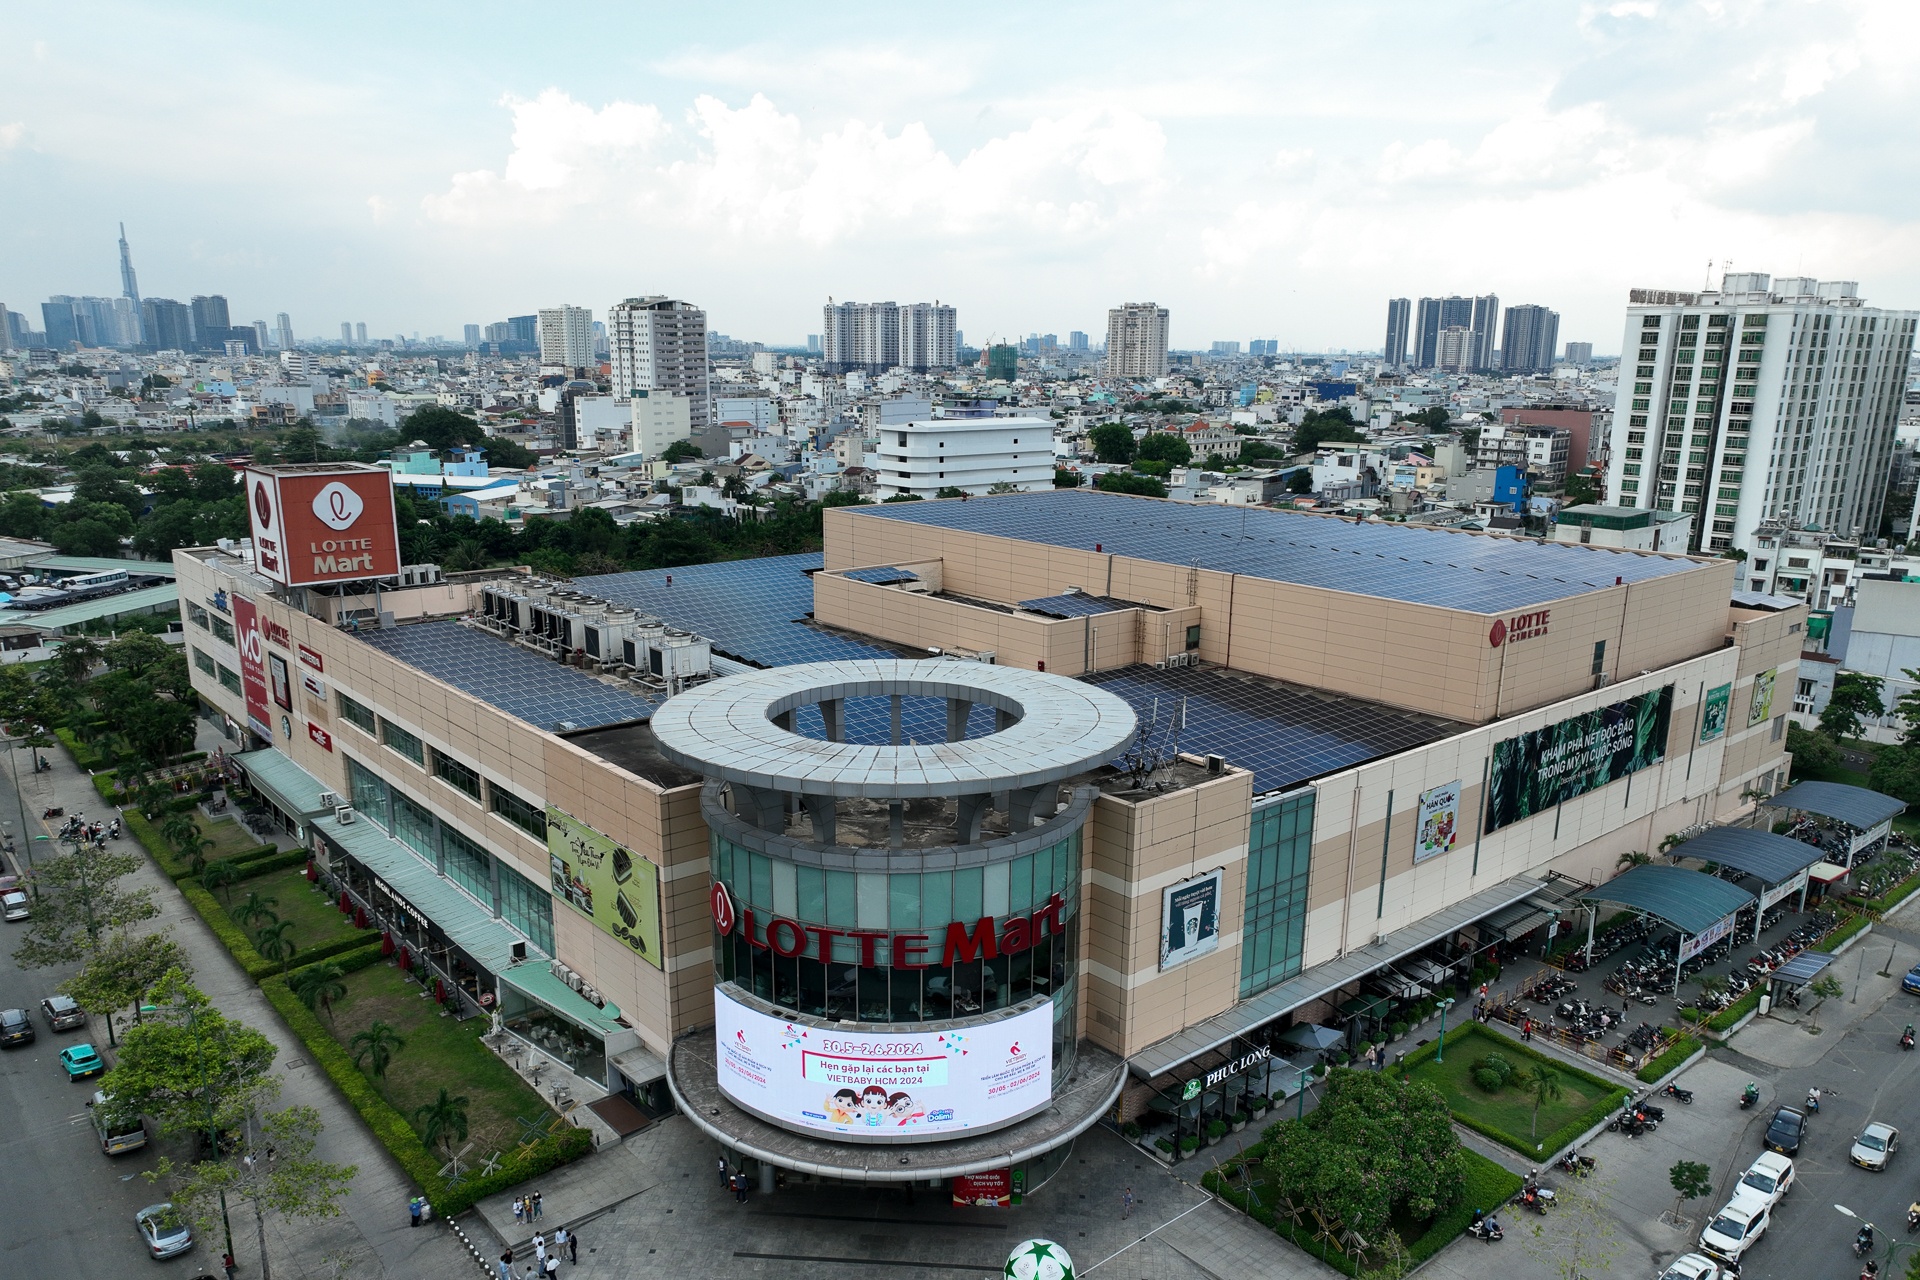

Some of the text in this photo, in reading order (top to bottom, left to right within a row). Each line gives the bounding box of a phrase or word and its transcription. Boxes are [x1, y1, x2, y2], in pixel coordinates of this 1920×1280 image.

[259, 536, 277, 553] LOTTE
[310, 538, 372, 554] LOTTE
[261, 551, 280, 575] Mart
[313, 552, 374, 575] Mart
[269, 620, 289, 642] LOTTE
[1510, 609, 1551, 632] LOTTE
[1509, 626, 1548, 643] CINEMA
[1541, 717, 1635, 764] KHÁM PHÁ NÉT ĐỘC ĐÁO
[1537, 761, 1566, 783] TRONG
[1566, 752, 1581, 774] MỸ
[1581, 750, 1590, 767] VỊ
[1589, 743, 1612, 764] CUỘC
[1612, 734, 1633, 753] SỐNG
[1426, 799, 1439, 810] HÀN
[374, 877, 429, 929] HIGHLANDS COFFEE
[743, 892, 1065, 971] LOTTE Mart
[820, 1060, 930, 1075] Hẹn gặp lại các bạn tại
[1005, 1053, 1027, 1064] VIETBABY
[1240, 1045, 1271, 1070] LONG
[827, 1073, 923, 1085] VIETBABY HCM 2024
[988, 1084, 1007, 1095] 30/05
[1009, 1070, 1040, 1088] 02/06/2024
